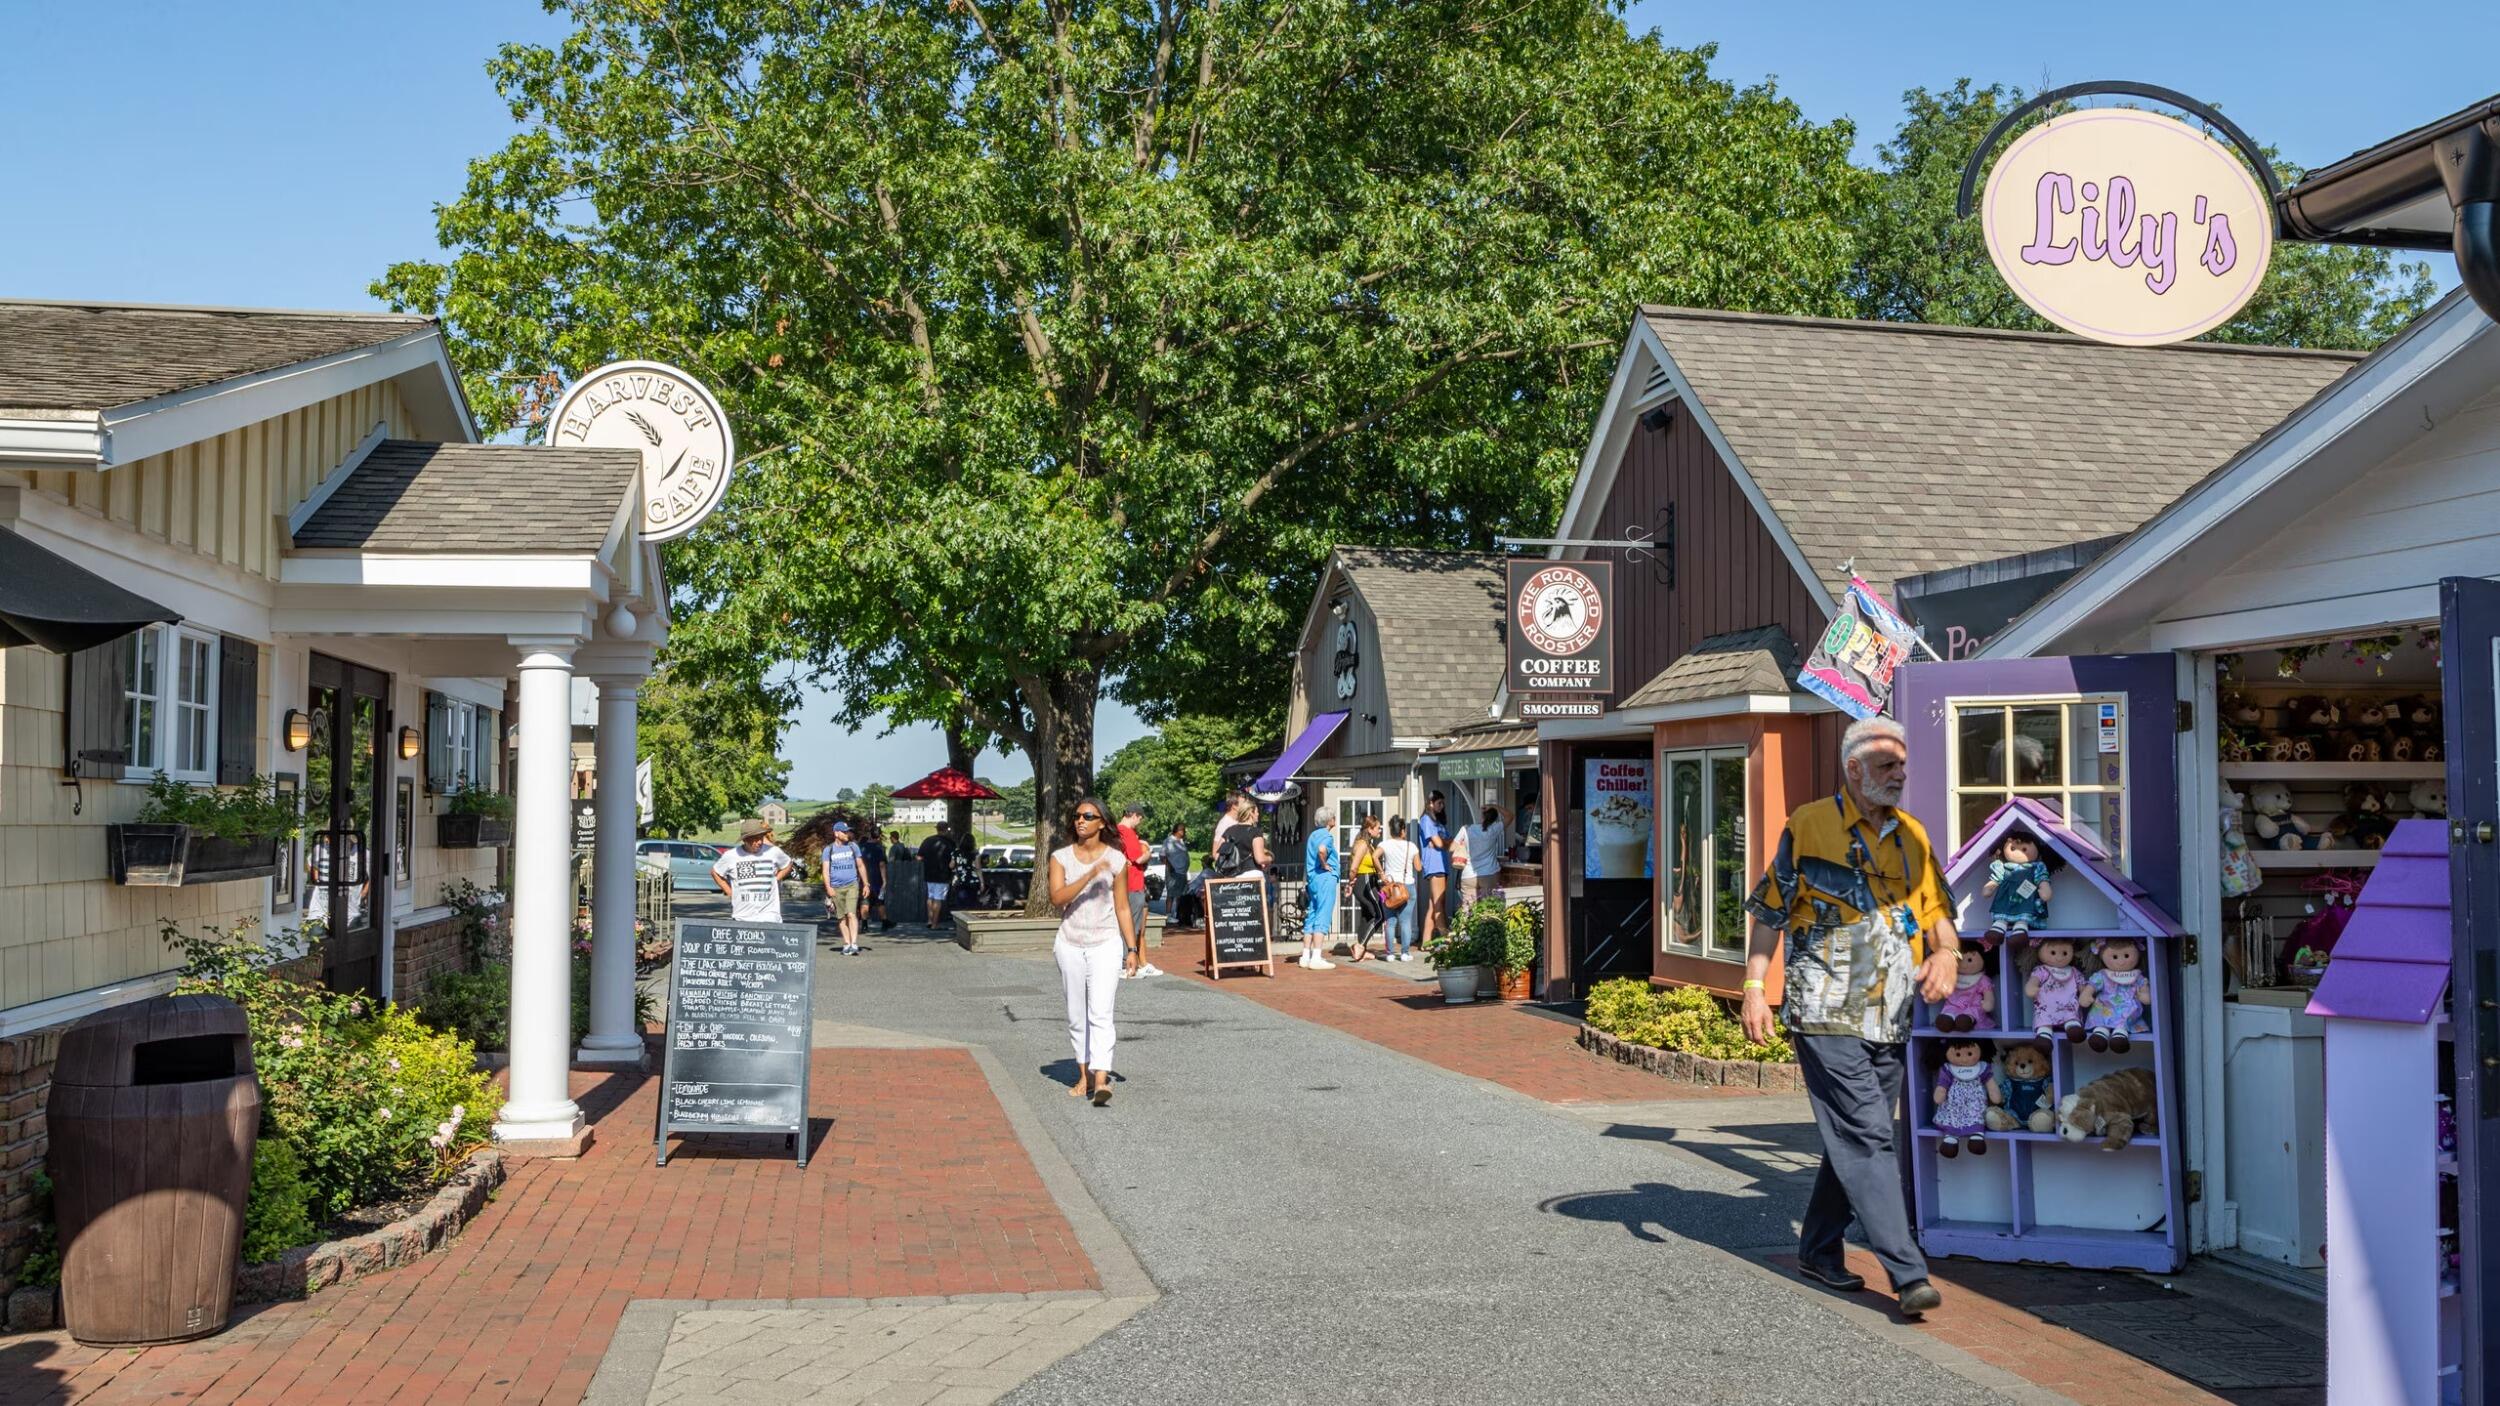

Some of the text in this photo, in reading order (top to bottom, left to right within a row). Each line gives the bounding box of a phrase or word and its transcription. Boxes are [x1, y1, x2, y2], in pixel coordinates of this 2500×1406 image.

[2020, 171, 2237, 296] Lily's
[562, 374, 712, 442] HARVEST
[647, 455, 715, 523] CAFE
[1521, 570, 1600, 618] THE ROASTED
[1525, 624, 1595, 652] ROOSTER
[1824, 613, 1908, 686] OPEN
[1520, 658, 1600, 674] COFFEE
[1529, 676, 1592, 688] COMPANY
[1522, 704, 1599, 715] SMOOTHIES
[1440, 757, 1500, 776] PRETZELS DRINKS
[1600, 764, 1645, 777] Coffee
[1596, 779, 1648, 792] Chiller!
[711, 928, 766, 942] CAFE SPECIALS
[704, 943, 712, 953] OF
[715, 943, 728, 954] THE
[675, 1098, 696, 1106] BLACK
[697, 1098, 719, 1106] CHERRY
